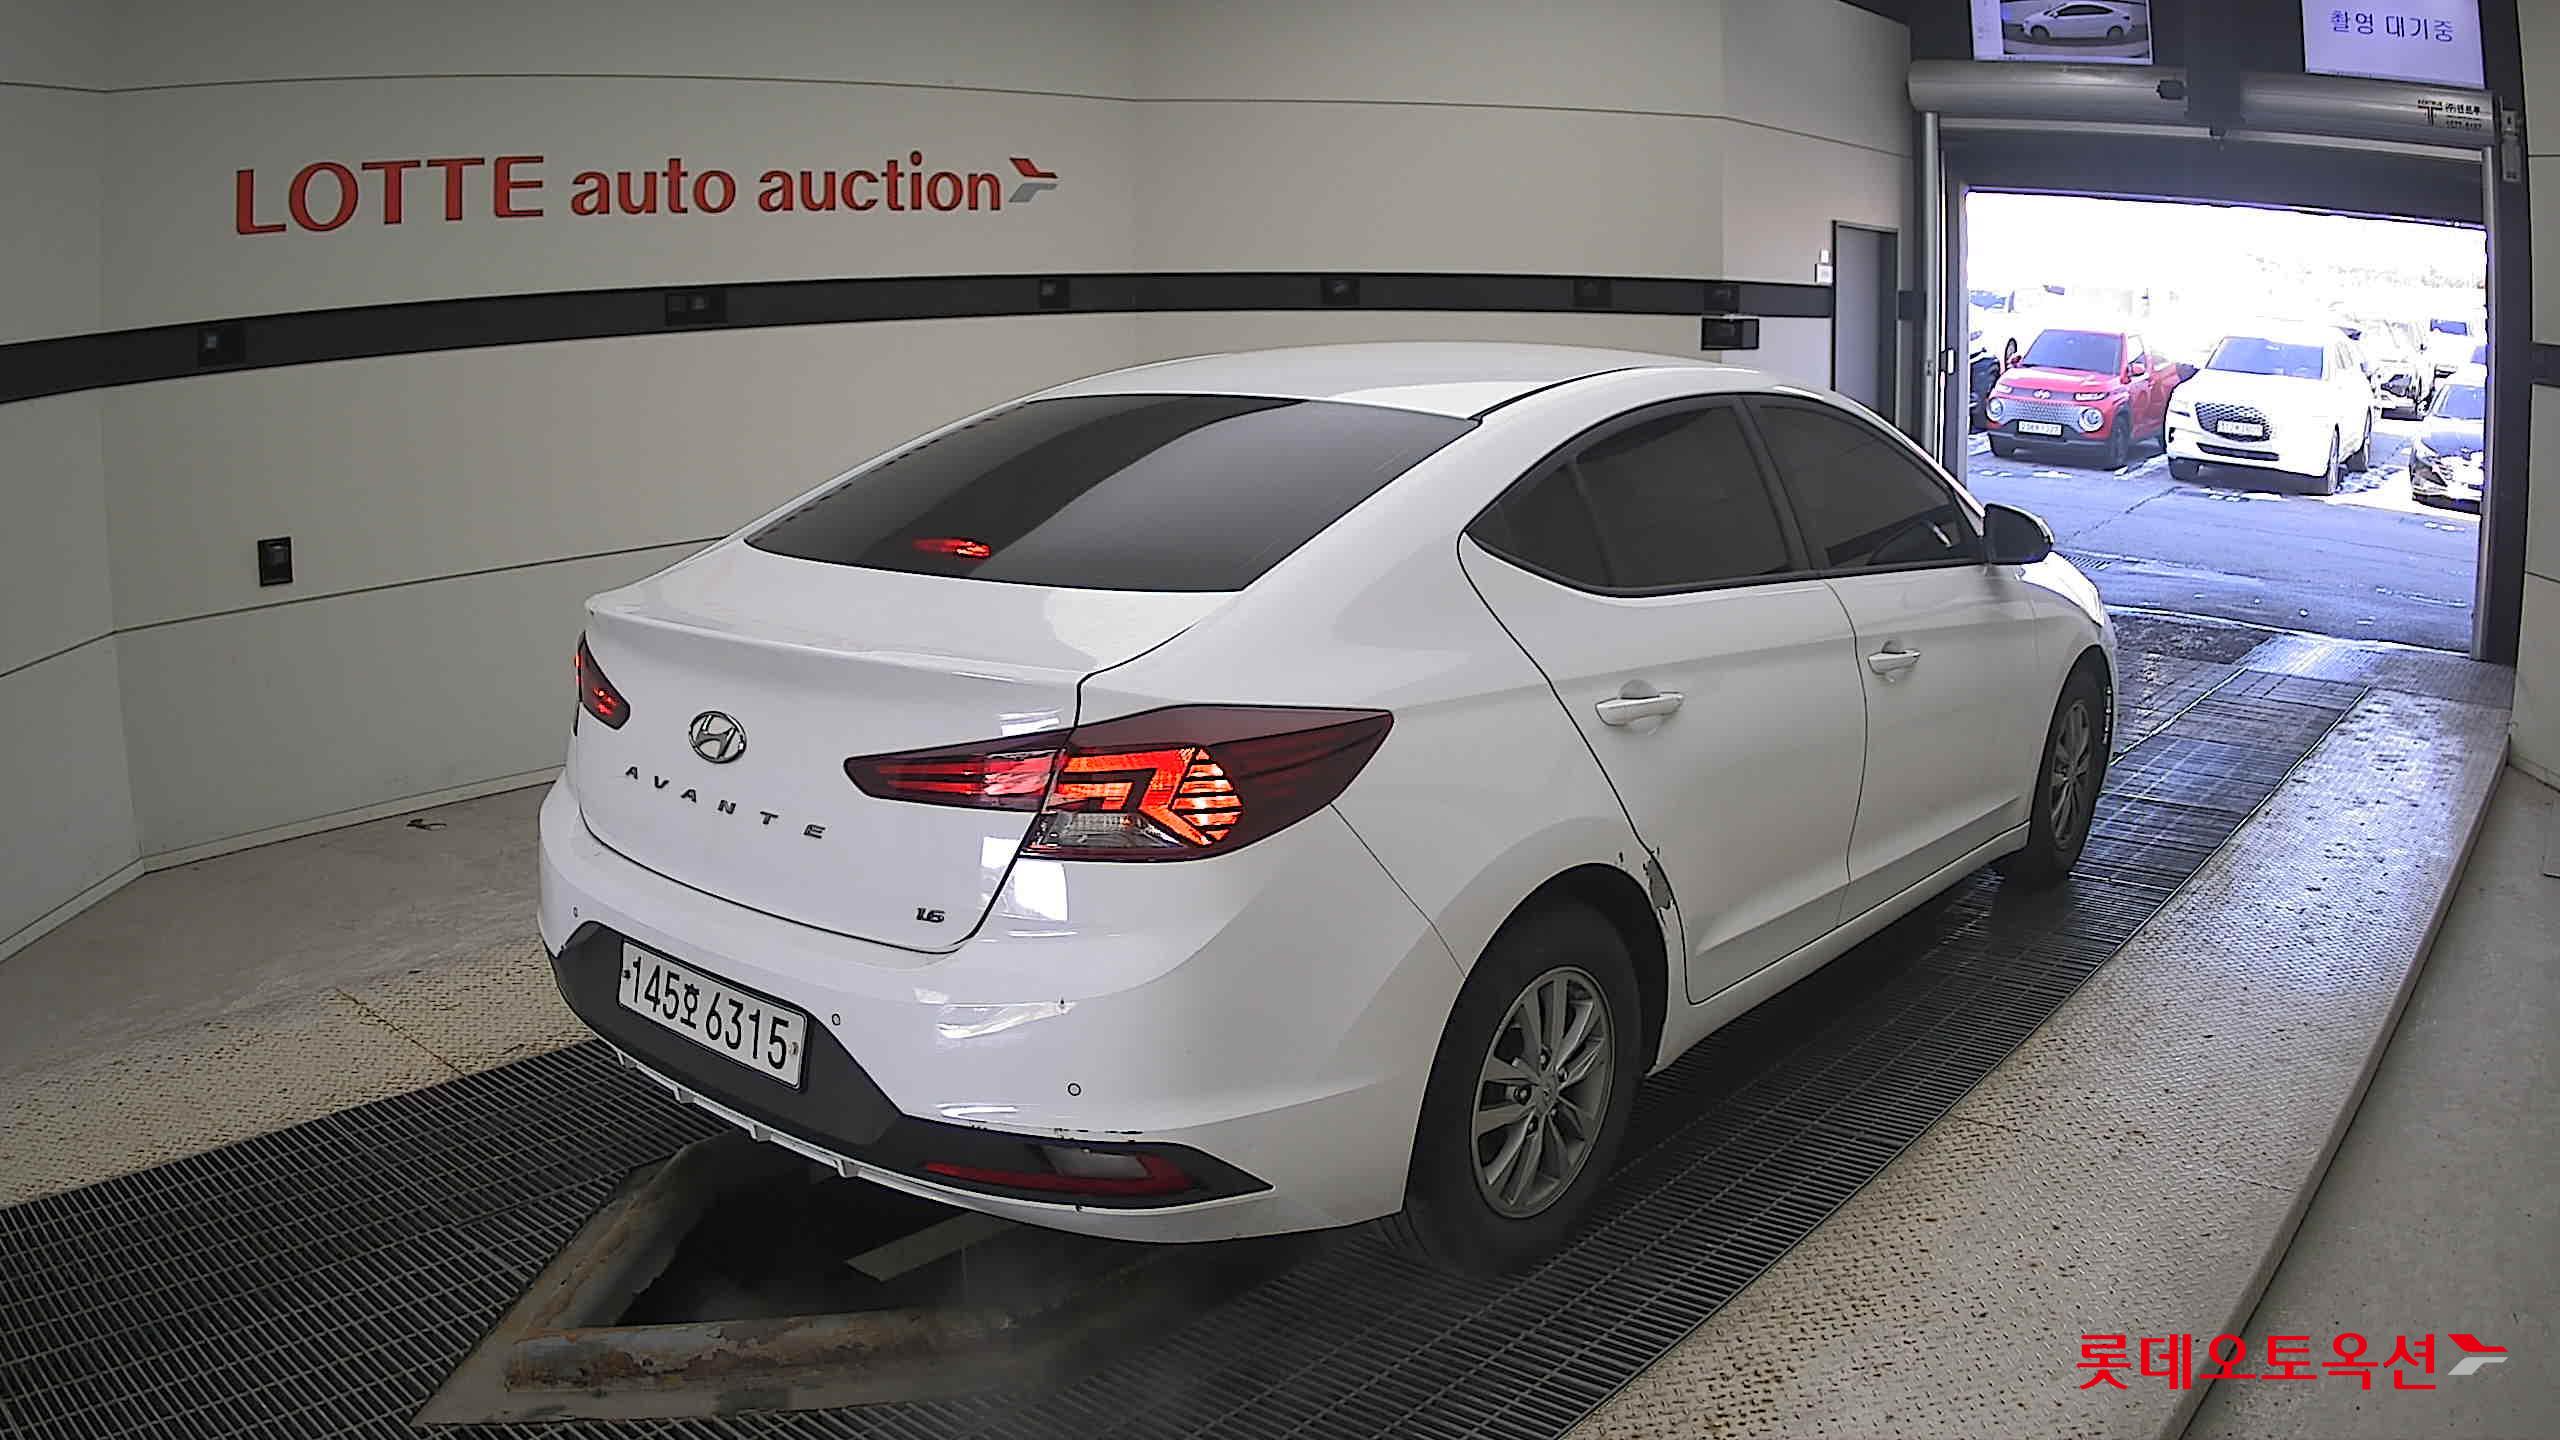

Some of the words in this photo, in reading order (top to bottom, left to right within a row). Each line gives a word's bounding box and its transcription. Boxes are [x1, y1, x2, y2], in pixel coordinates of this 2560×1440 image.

[2330, 9, 2375, 36] 촬영
[2385, 14, 2455, 43] 대기중
[235, 155, 545, 234] LOTTE
[570, 157, 738, 216] auto
[757, 150, 1003, 214] auction
[624, 764, 828, 841] AVANTE
